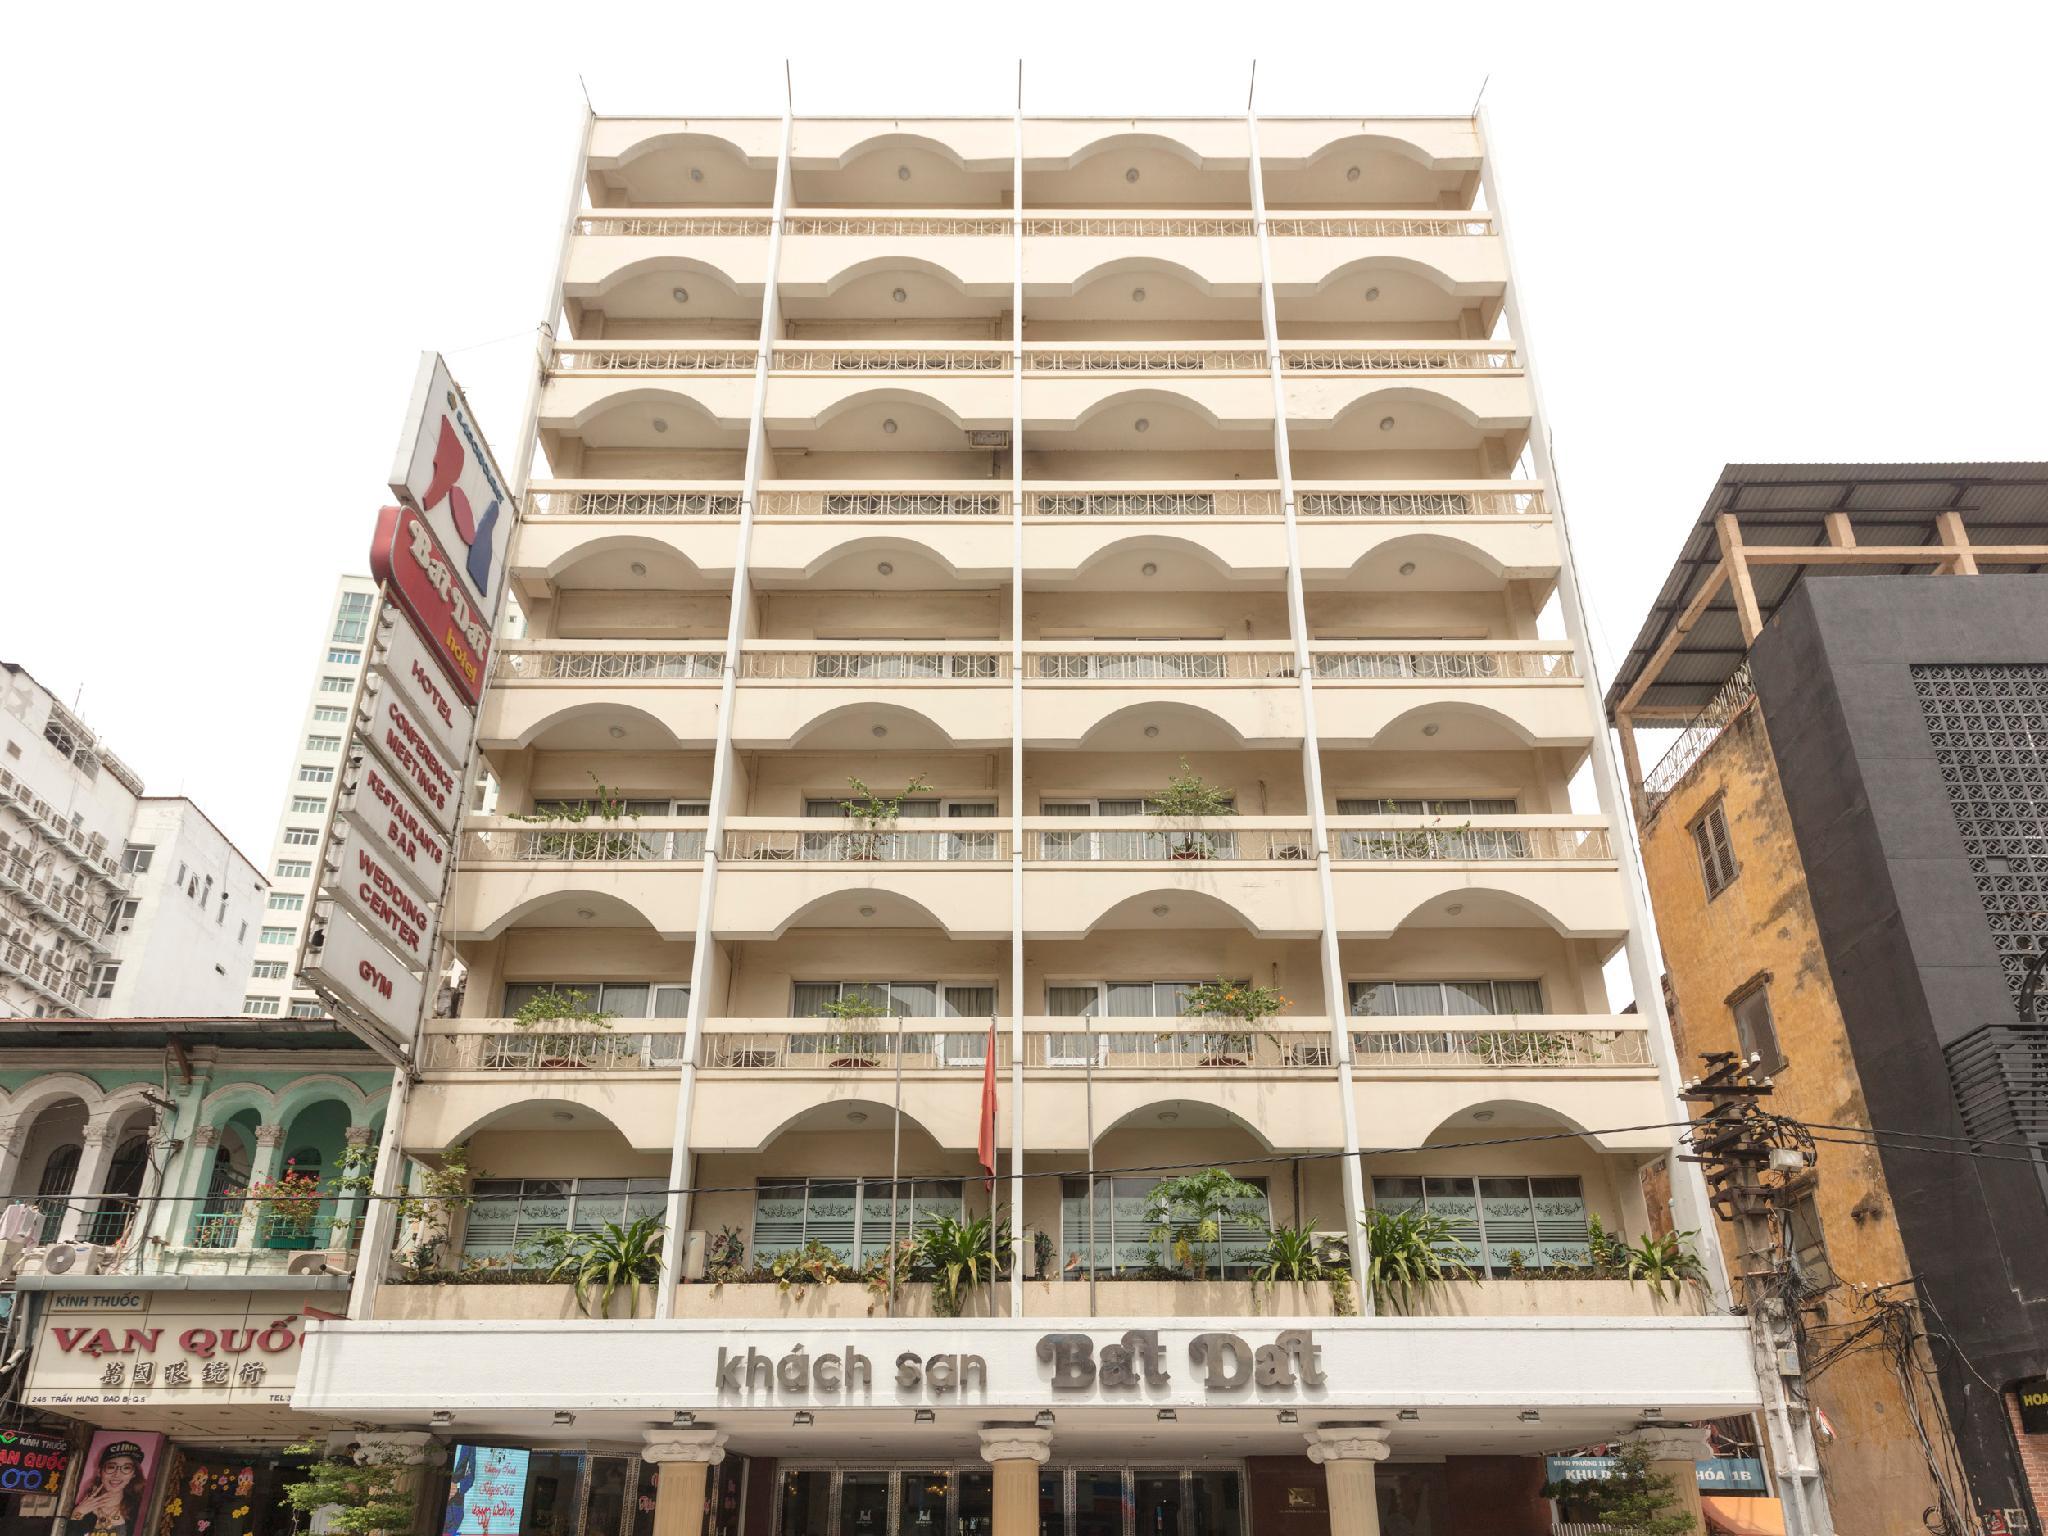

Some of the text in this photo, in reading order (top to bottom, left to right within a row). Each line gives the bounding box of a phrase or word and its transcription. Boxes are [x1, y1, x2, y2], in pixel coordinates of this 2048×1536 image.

[445, 628, 478, 683] hotel
[411, 659, 453, 728] HOTEL
[386, 728, 446, 810] MEETINGS
[389, 703, 454, 795] CONFERENCE
[367, 769, 443, 864] RESTAURANTS
[387, 820, 416, 862] BAR
[359, 849, 428, 931] WEDDING
[359, 882, 420, 952] CENTER
[359, 960, 393, 1000] GYM
[55, 1291, 141, 1307] KÍNH THUỐC
[51, 1315, 305, 1358] VẠN QUỐ
[715, 1343, 873, 1391] khách
